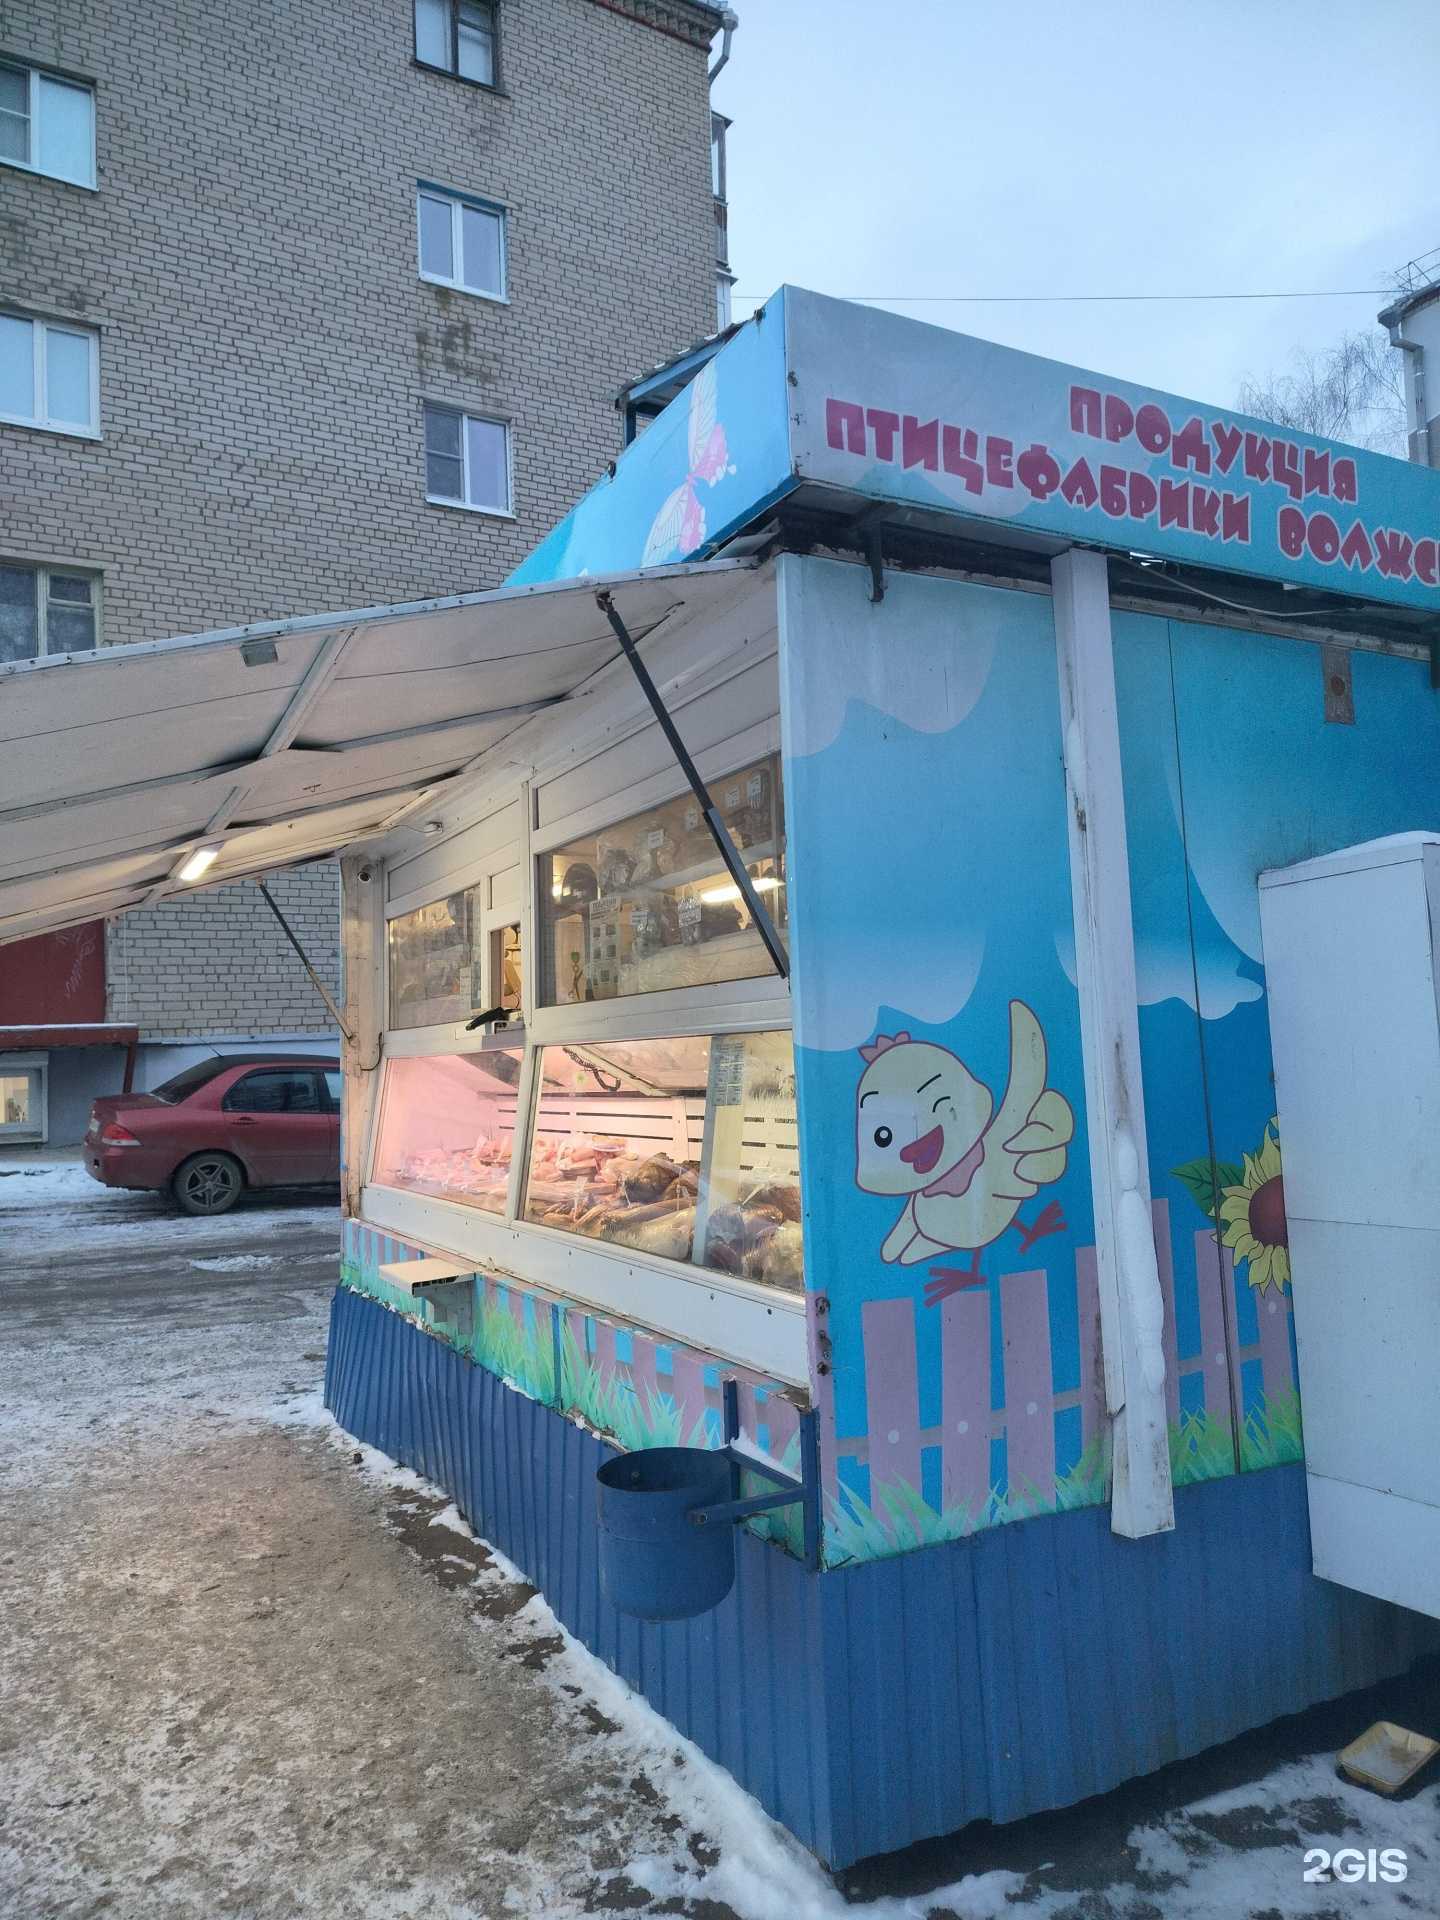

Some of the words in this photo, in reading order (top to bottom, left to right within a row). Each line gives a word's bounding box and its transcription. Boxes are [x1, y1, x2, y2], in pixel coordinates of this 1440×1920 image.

[825, 397, 1250, 543] ПТИЦЕФАБРИКИ
[1279, 507, 1440, 584] ВОЛЖС
[1070, 385, 1358, 502] ПРОДУКЦИЯ
